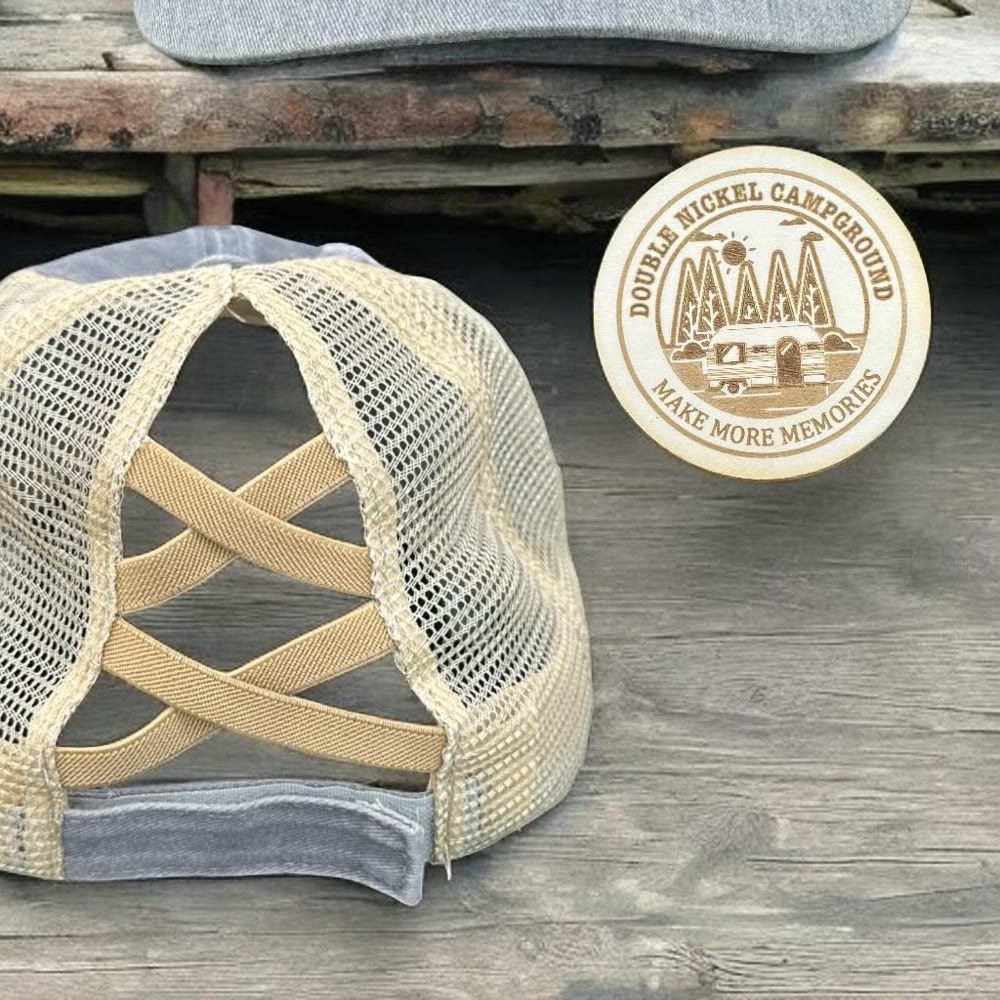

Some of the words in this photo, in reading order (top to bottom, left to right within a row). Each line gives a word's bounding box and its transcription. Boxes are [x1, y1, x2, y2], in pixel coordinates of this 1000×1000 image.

[630, 224, 677, 318] DOUBLE
[673, 181, 764, 230] NICKEL
[770, 182, 894, 301] CAMPGROUND
[651, 379, 709, 430] MAKE
[709, 421, 774, 446] MORE
[780, 368, 882, 446] MEMORIES
